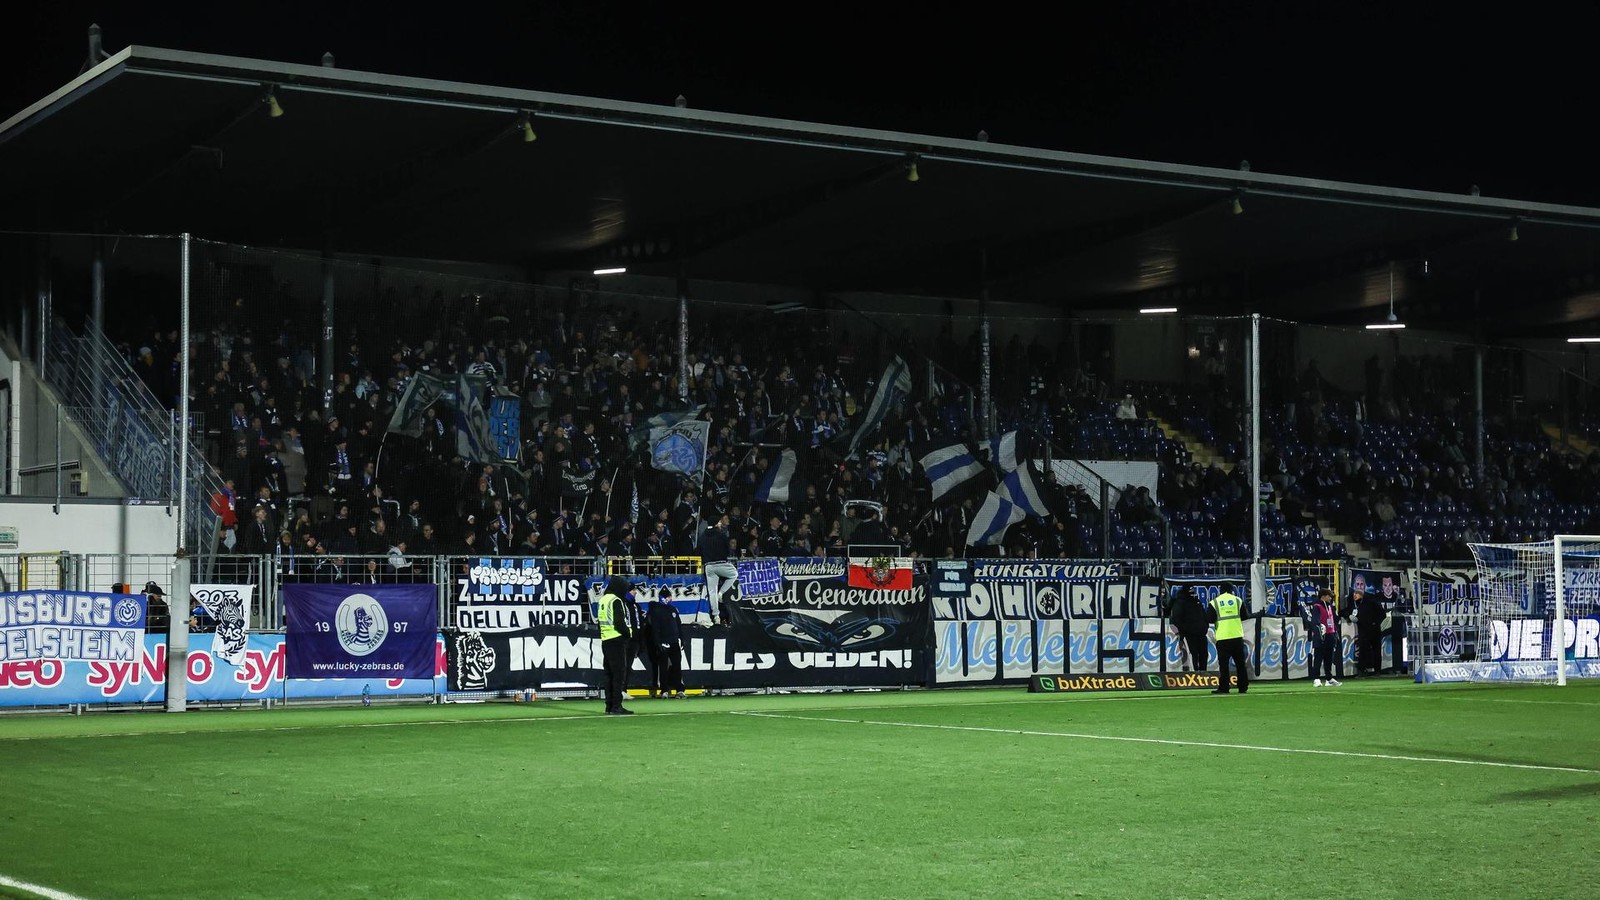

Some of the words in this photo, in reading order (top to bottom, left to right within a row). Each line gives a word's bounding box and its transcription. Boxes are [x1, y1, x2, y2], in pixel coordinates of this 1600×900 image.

[315, 621, 331, 633] 19
[394, 621, 408, 633] 97
[460, 610, 519, 628] DELLA
[529, 610, 579, 627] NORD
[1489, 619, 1544, 660] DIE
[1550, 618, 1600, 659] PR
[312, 662, 405, 672] www.lucky-zebras.de
[1059, 675, 1136, 691] buXtrade
[1165, 673, 1238, 689] buXtrae
